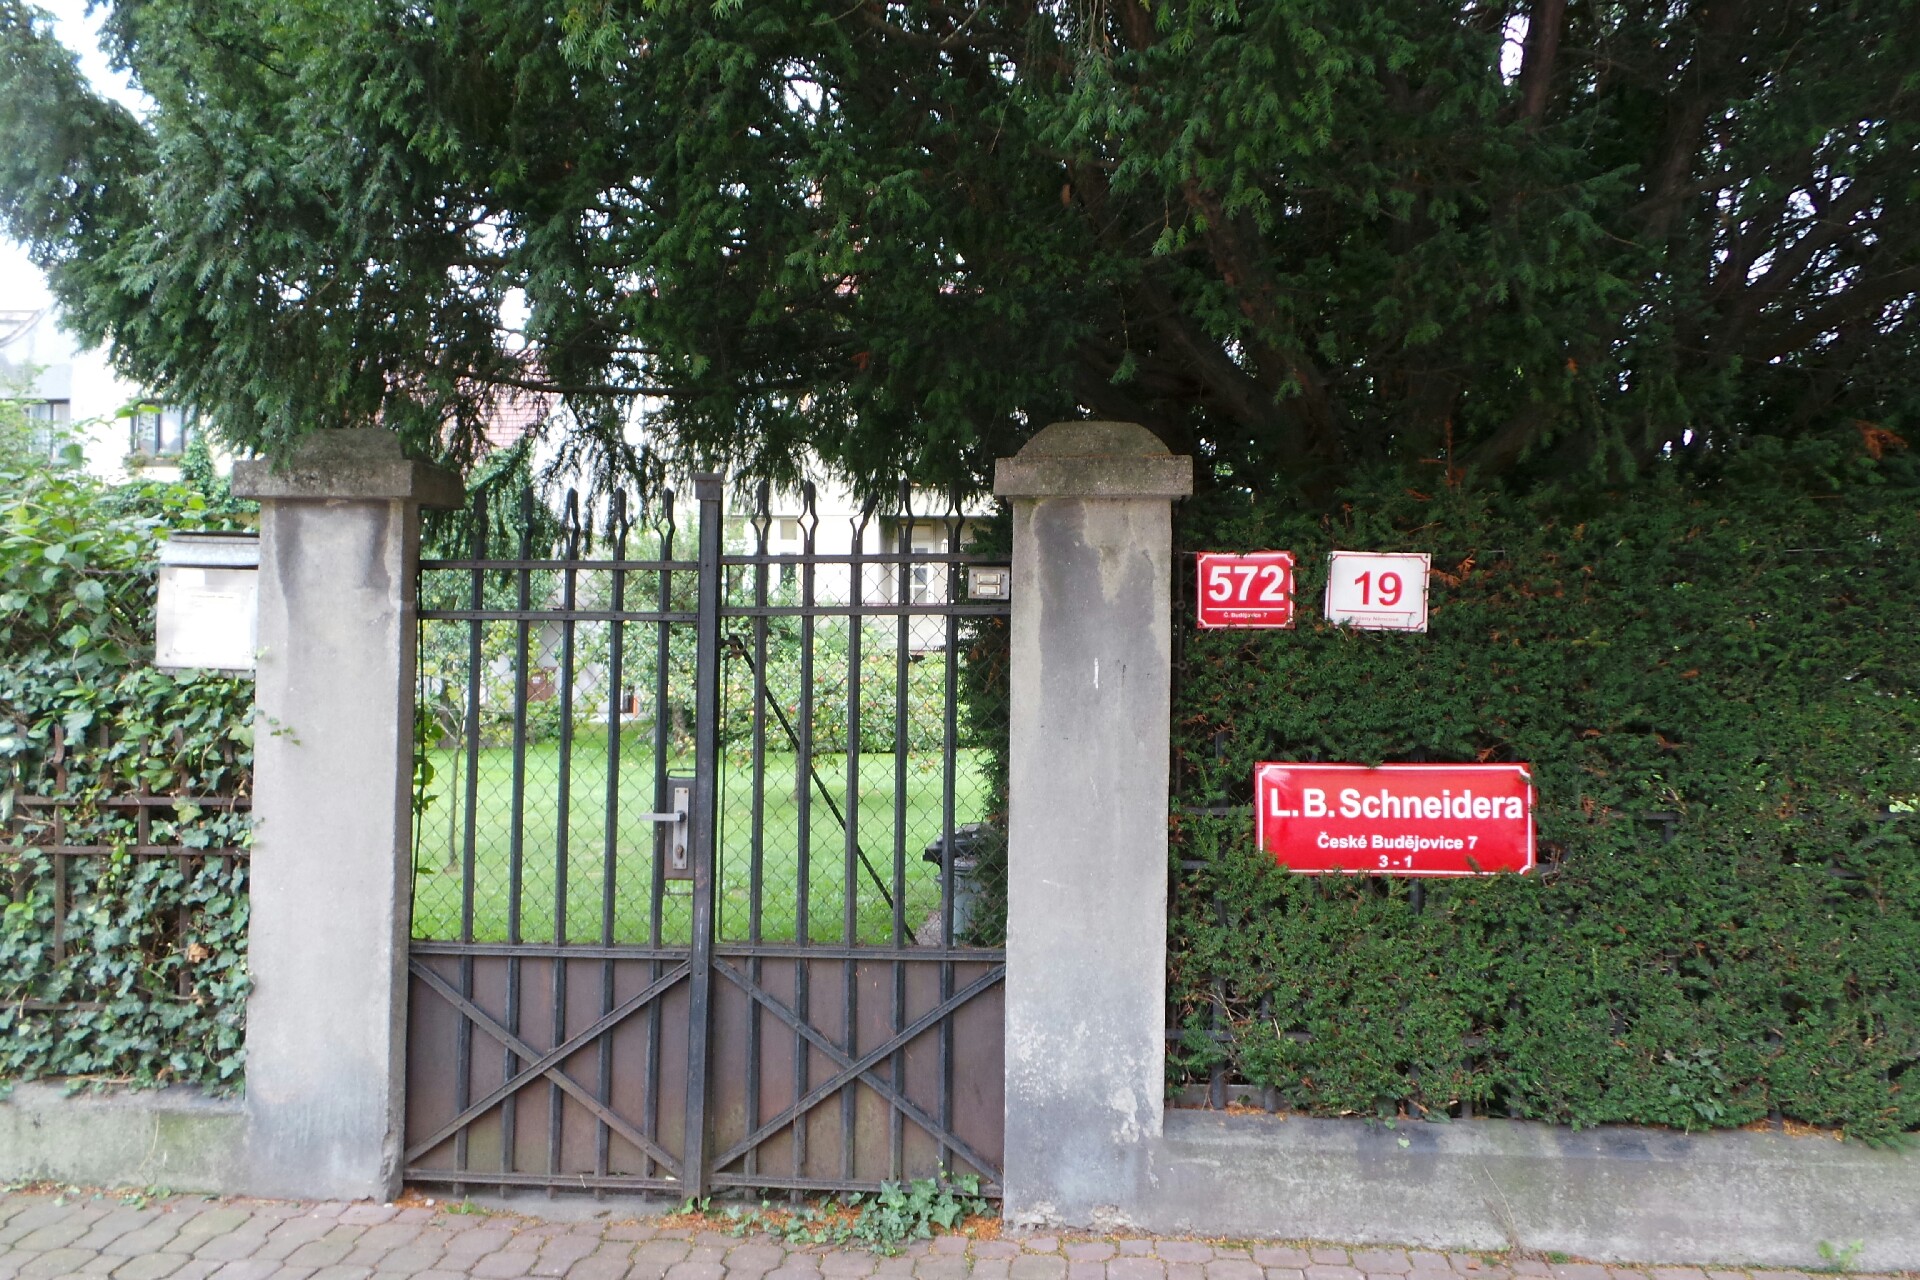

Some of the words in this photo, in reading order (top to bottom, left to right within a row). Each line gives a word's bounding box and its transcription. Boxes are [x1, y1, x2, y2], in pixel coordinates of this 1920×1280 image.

[1208, 564, 1284, 602] 572
[1354, 570, 1403, 606] 19
[1317, 832, 1368, 850] České
[1372, 834, 1464, 852] Budějovice
[1468, 835, 1478, 849] 7
